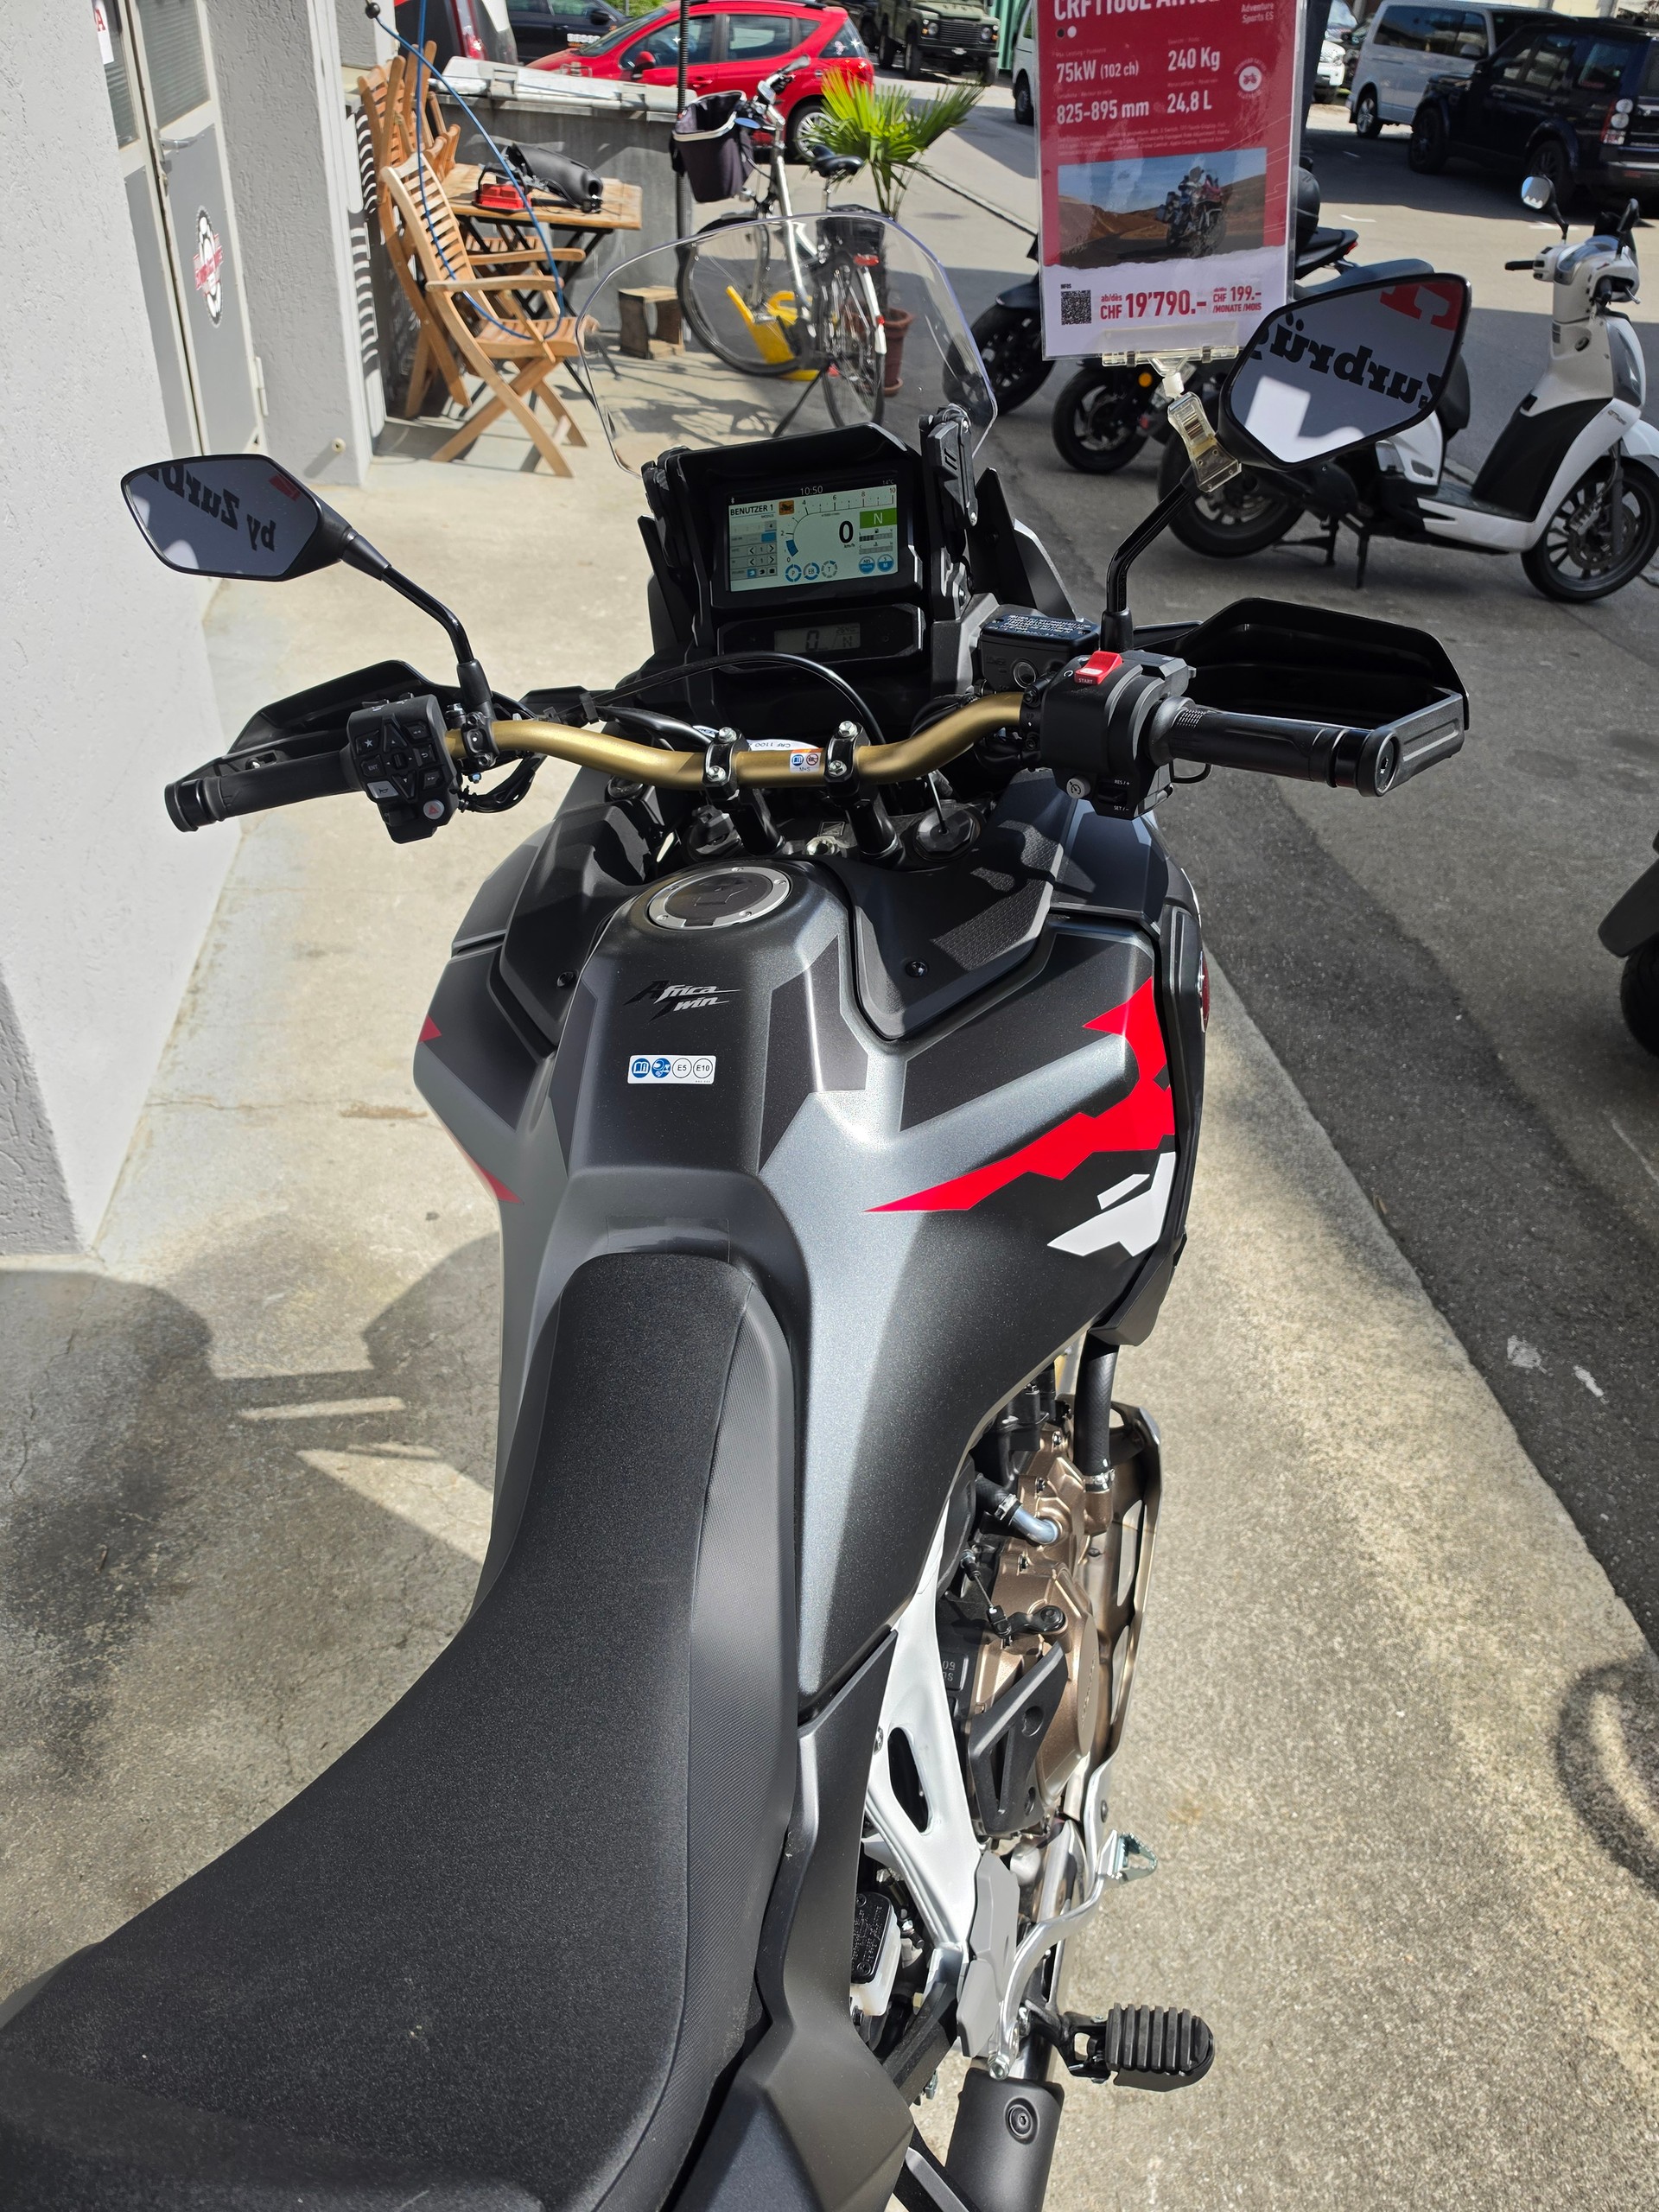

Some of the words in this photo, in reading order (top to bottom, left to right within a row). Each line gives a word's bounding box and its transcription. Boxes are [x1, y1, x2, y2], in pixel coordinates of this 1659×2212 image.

[1168, 49, 1197, 72] 240
[1201, 47, 1221, 71] Kg
[1057, 60, 1096, 83] 75kW
[1100, 63, 1122, 80] (102
[1123, 60, 1140, 76] ch)
[1057, 99, 1118, 124] 825-895
[1122, 100, 1150, 118] mm
[1167, 91, 1199, 114] 24,8
[1203, 90, 1212, 111] L
[1100, 304, 1122, 320] CHF
[1125, 289, 1207, 318] 19'790.-
[1101, 293, 1122, 302] ab/dès
[1212, 293, 1227, 302] CHF
[1230, 285, 1262, 302] 199.-
[800, 486, 823, 496] 10:50
[730, 505, 769, 517] BENUTZER
[874, 512, 884, 524] N
[839, 520, 854, 543] 0
